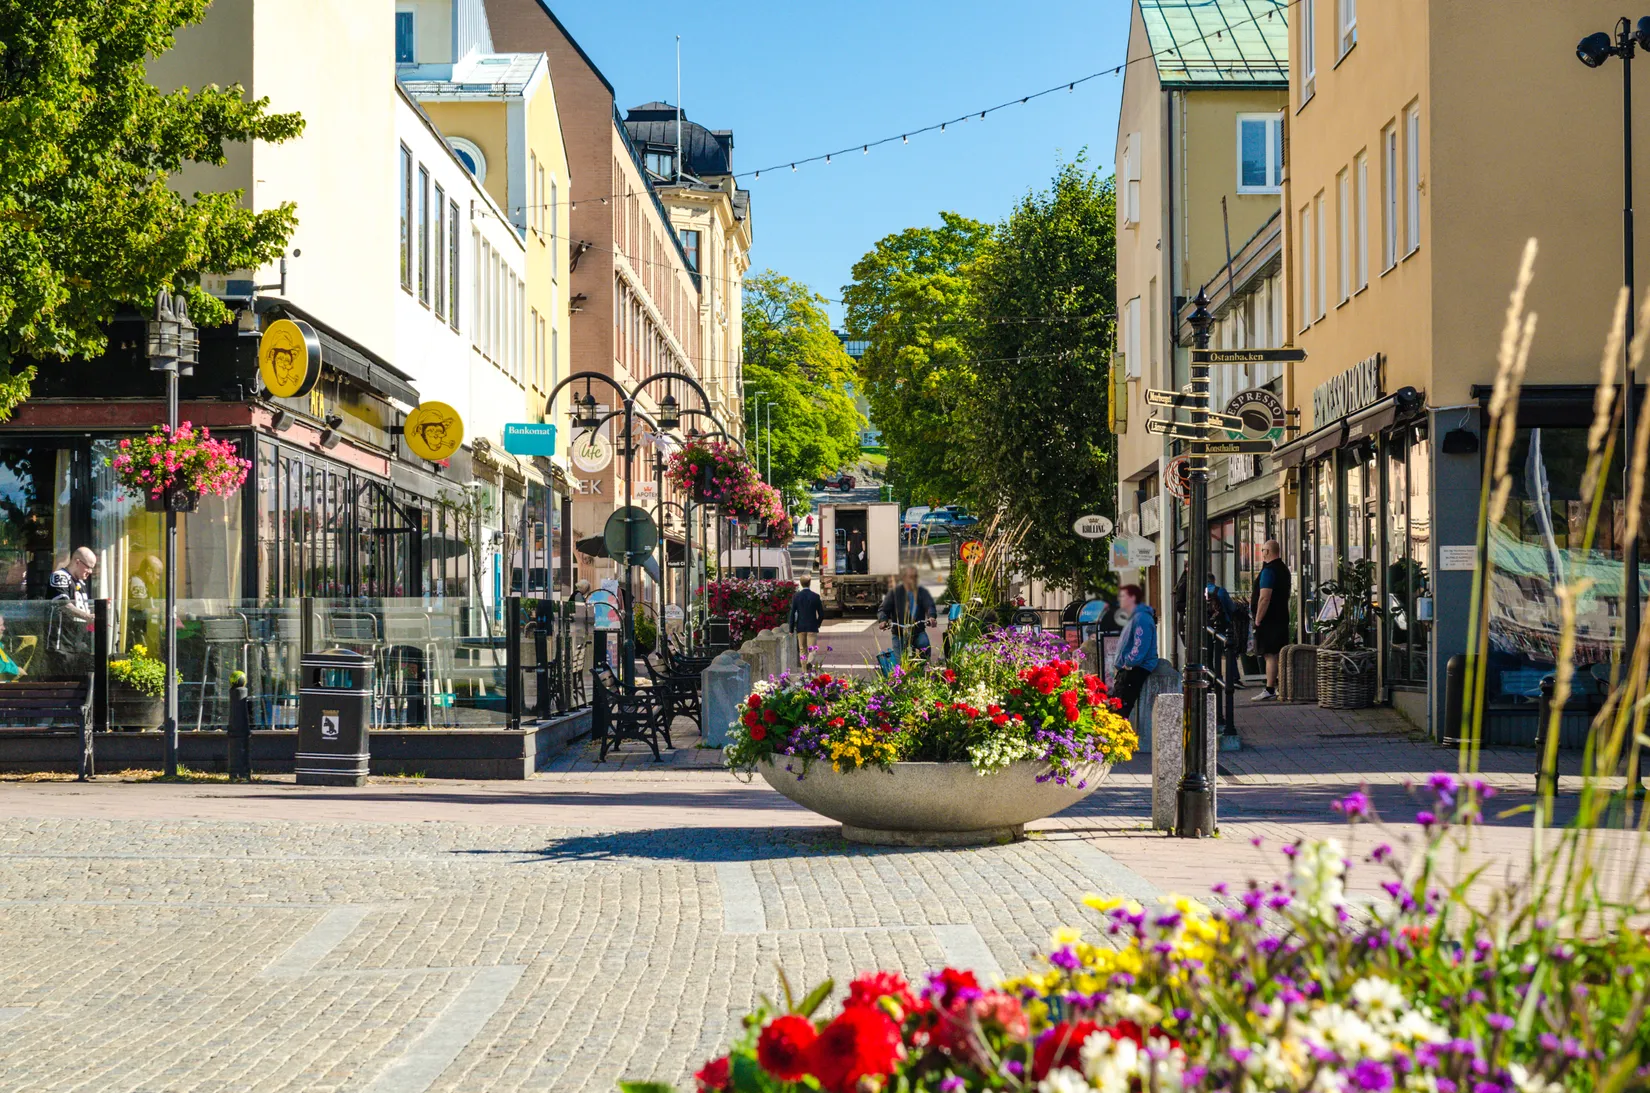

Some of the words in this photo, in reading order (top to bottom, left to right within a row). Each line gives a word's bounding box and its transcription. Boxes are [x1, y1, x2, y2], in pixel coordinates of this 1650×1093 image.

[1348, 353, 1377, 413] HOUSE
[1227, 392, 1282, 416] ESPRESSO
[508, 426, 550, 435] Bankomat
[1205, 443, 1240, 453] Konsthallen
[577, 479, 602, 495] EK
